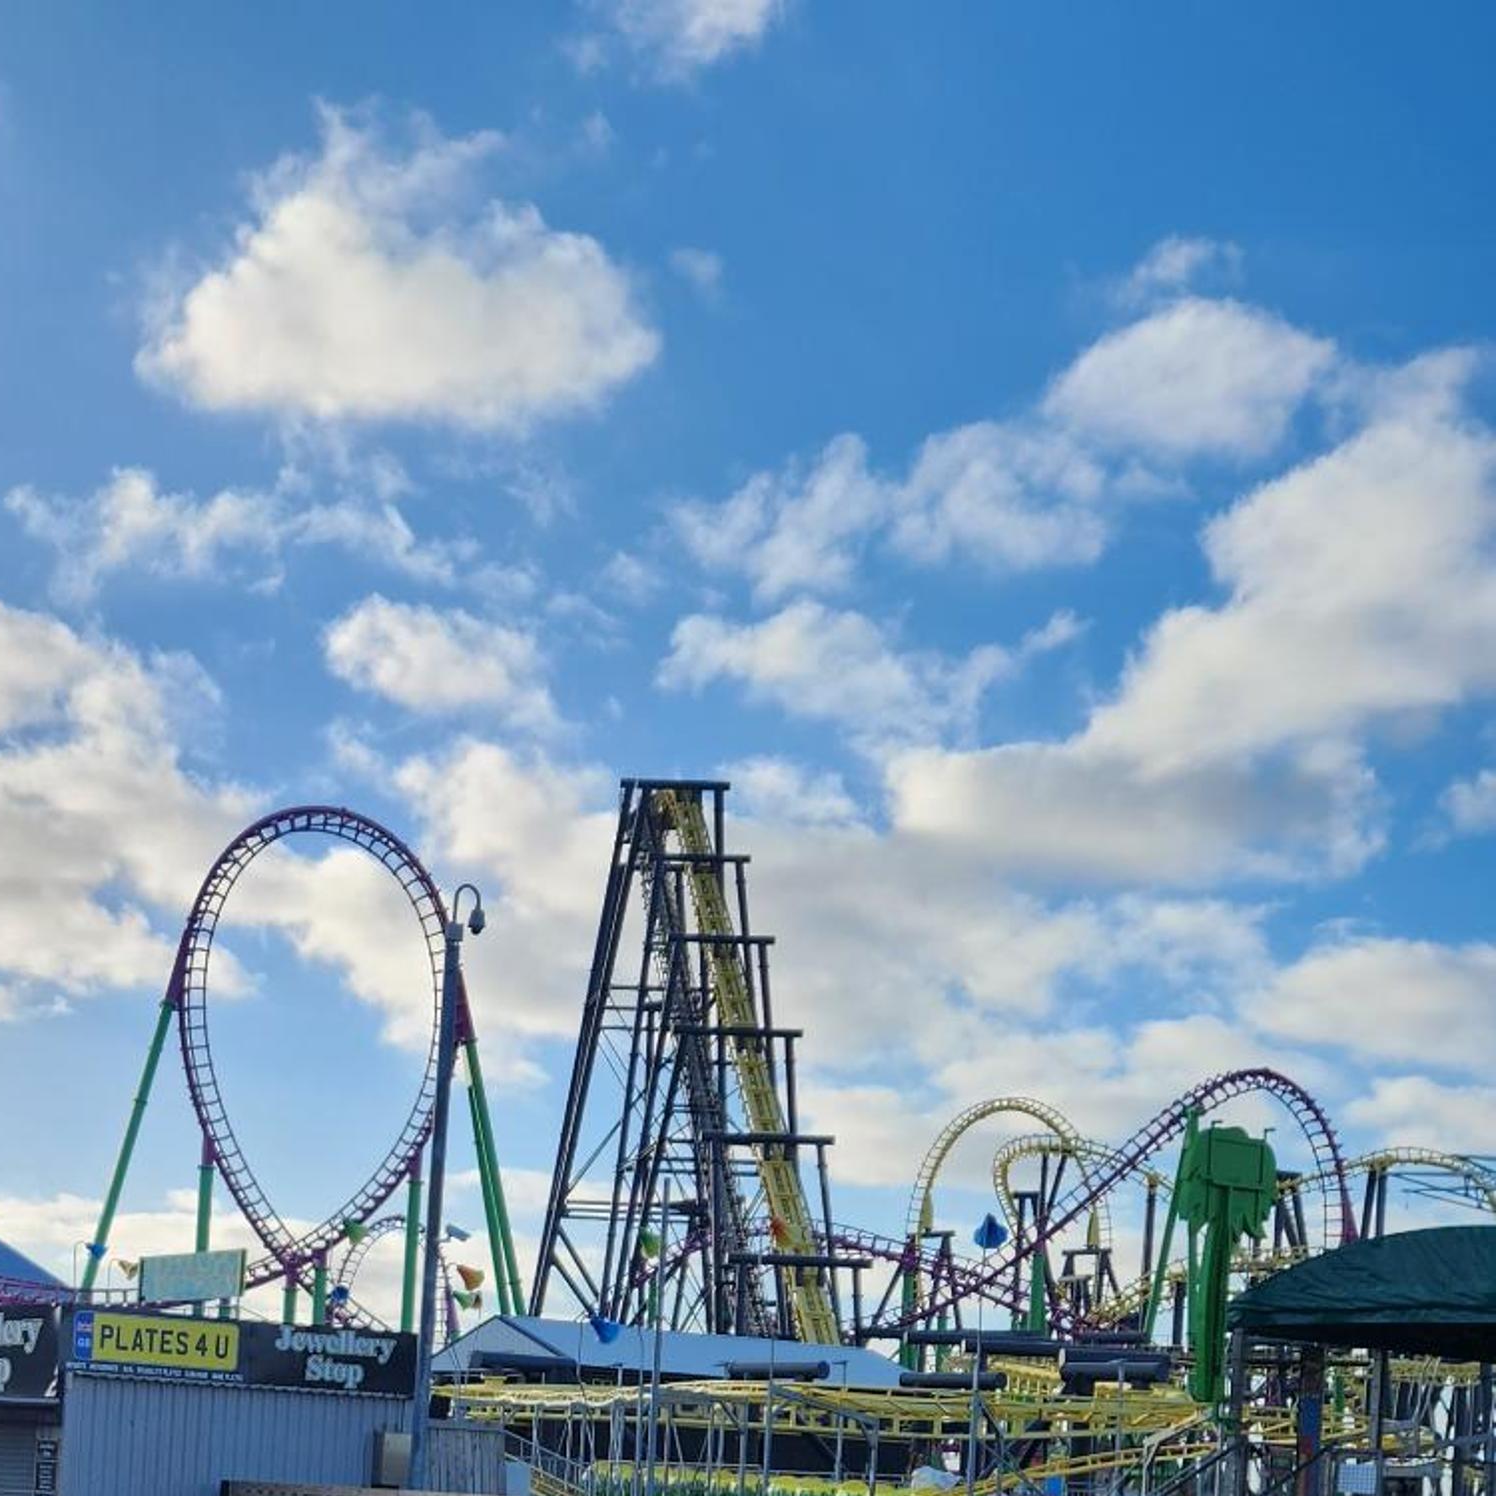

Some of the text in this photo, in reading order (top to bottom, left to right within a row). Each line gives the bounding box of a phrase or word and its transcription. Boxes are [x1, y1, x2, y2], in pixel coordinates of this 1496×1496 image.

[100, 1324, 229, 1359] PLATES 4 U
[275, 1324, 398, 1365] Jewellery
[305, 1354, 365, 1389] Stop
